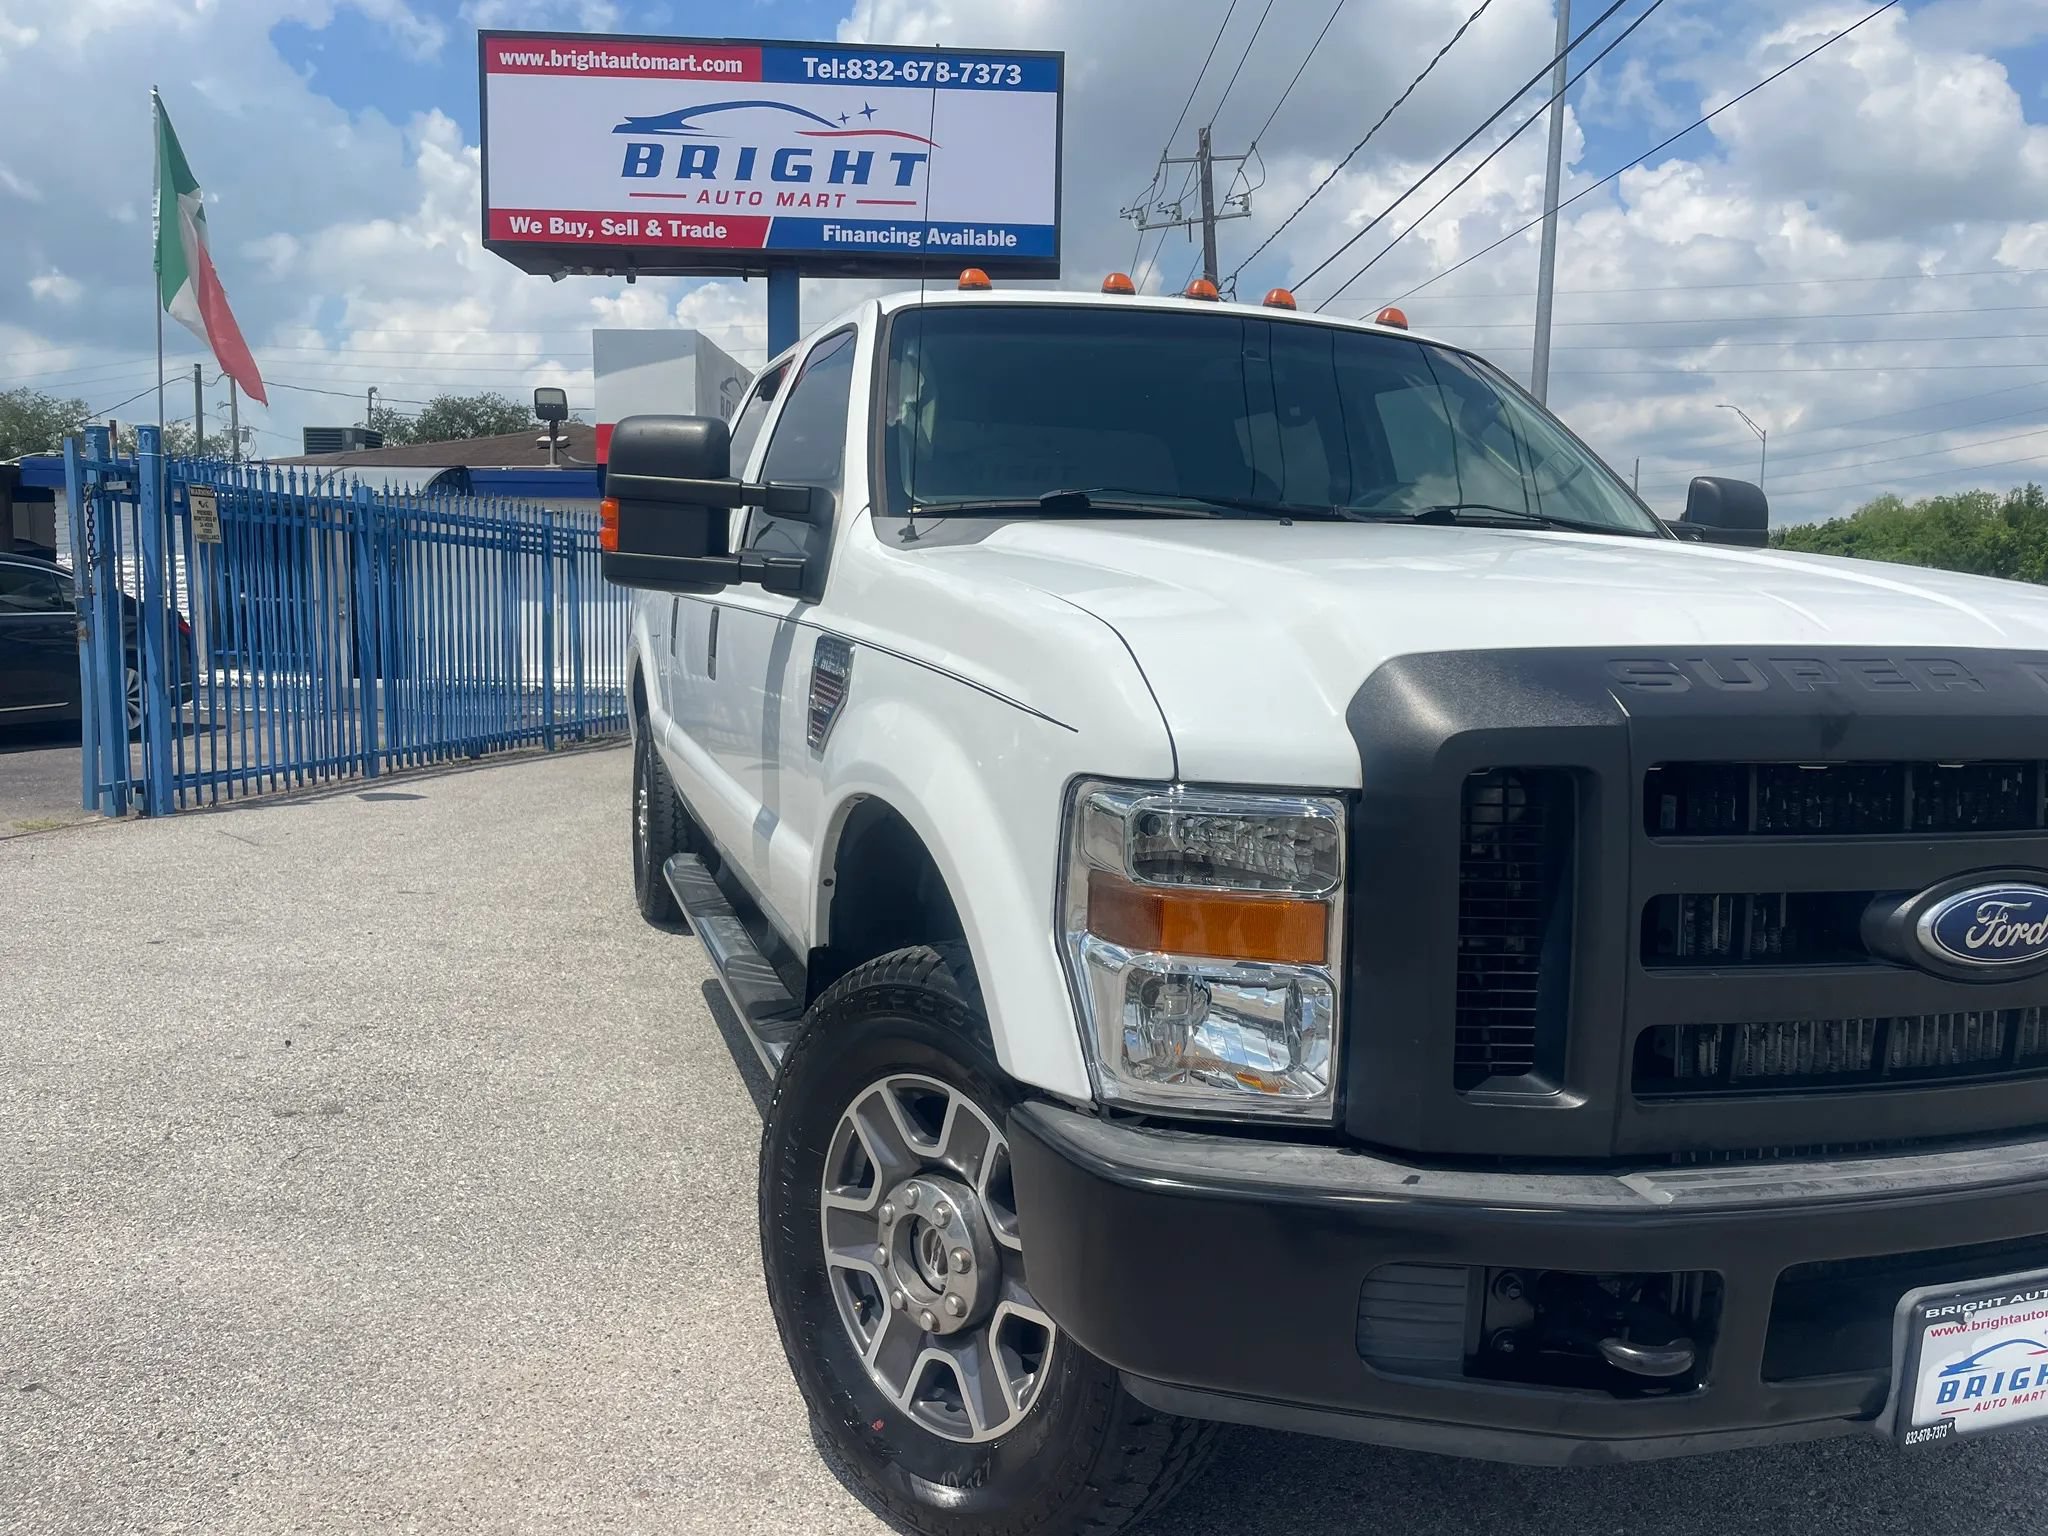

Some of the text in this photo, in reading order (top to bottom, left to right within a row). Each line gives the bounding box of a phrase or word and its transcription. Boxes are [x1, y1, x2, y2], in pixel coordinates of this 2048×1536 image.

[500, 49, 743, 73] www.brightautomart.com
[802, 57, 1022, 85] Tel:832-678-7373
[621, 142, 928, 186] BRIGHT
[696, 189, 847, 208] AUTO MART
[509, 216, 728, 239] We Buy, Sell & Trade
[822, 224, 1018, 247] Financing Available
[1607, 657, 1988, 693] SUPER
[1966, 900, 2048, 949] Ford
[1925, 1296, 2007, 1319] BRIGHT
[1973, 1389, 2047, 1413] AUTO MART
[1905, 1424, 1947, 1446] 832-678-7373
